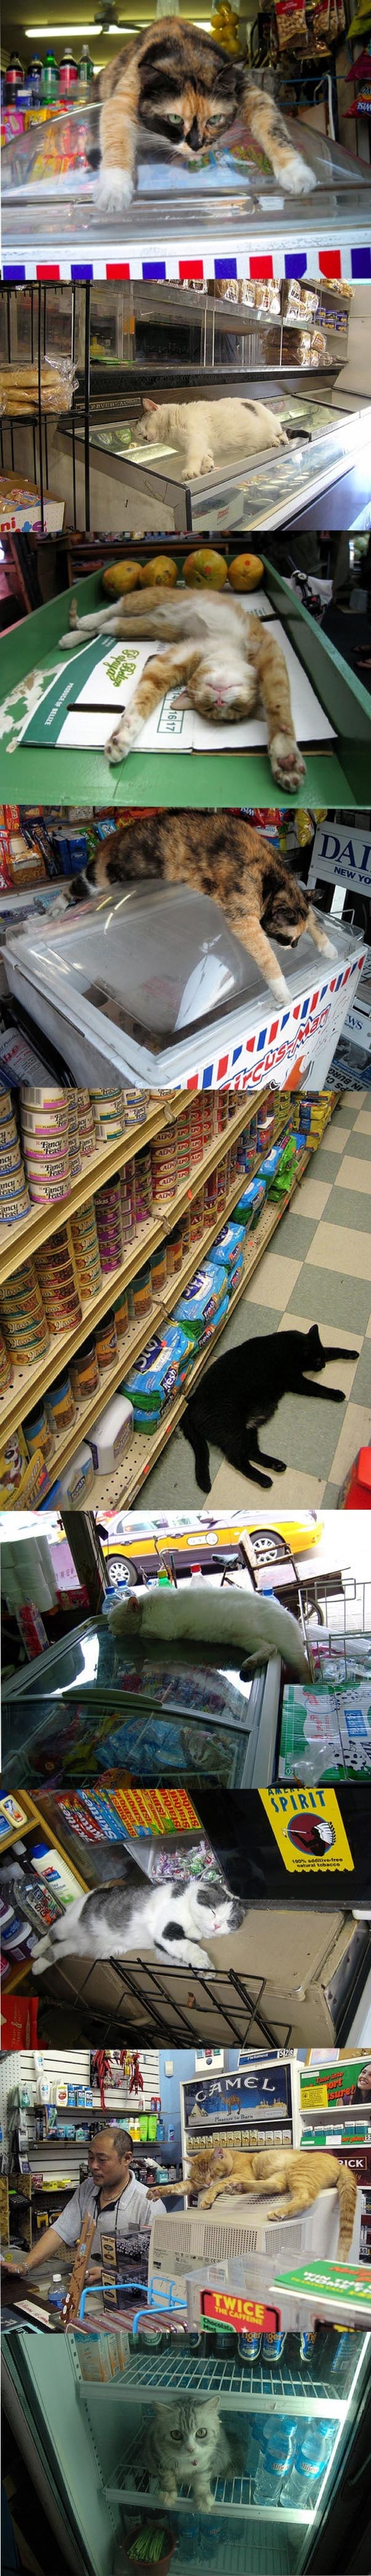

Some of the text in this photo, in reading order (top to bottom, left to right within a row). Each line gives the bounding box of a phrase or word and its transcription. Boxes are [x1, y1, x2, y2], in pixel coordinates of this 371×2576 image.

[44, 708, 58, 725] BELIZE
[168, 711, 177, 720] 16
[166, 722, 176, 731] 17
[317, 833, 370, 872] DAI
[333, 866, 370, 884] NEW YO
[347, 1014, 364, 1030] WS
[328, 1069, 352, 1087] BURG
[156, 1133, 173, 1141] ALPO
[41, 1140, 62, 1149] Fancy
[44, 1146, 62, 1155] Feast
[0, 1154, 12, 1162] ncy
[0, 1162, 12, 1171] east
[45, 1161, 65, 1171] Fancy
[49, 1167, 65, 1177] Feast
[0, 1180, 15, 1189] ancy
[43, 1186, 64, 1195] Fancy
[46, 1191, 65, 1200] Feast
[46, 1304, 60, 1315] Lives
[9, 1319, 31, 1332] 9Lives
[54, 1317, 75, 1330] 9Lives
[10, 1335, 32, 1348] 9Lives
[270, 1790, 326, 1813] SPIRIT
[111, 1795, 136, 1837] Starburst
[279, 2049, 295, 2058] 528
[316, 2075, 330, 2083] Tune
[327, 2078, 343, 2090] port
[195, 2076, 275, 2102] CAMEL
[303, 2271, 331, 2281] WIN
[213, 2294, 265, 2319] TWICE
[214, 2306, 264, 2326] THE CAFFEINE
[203, 2318, 234, 2331] Chocolate
